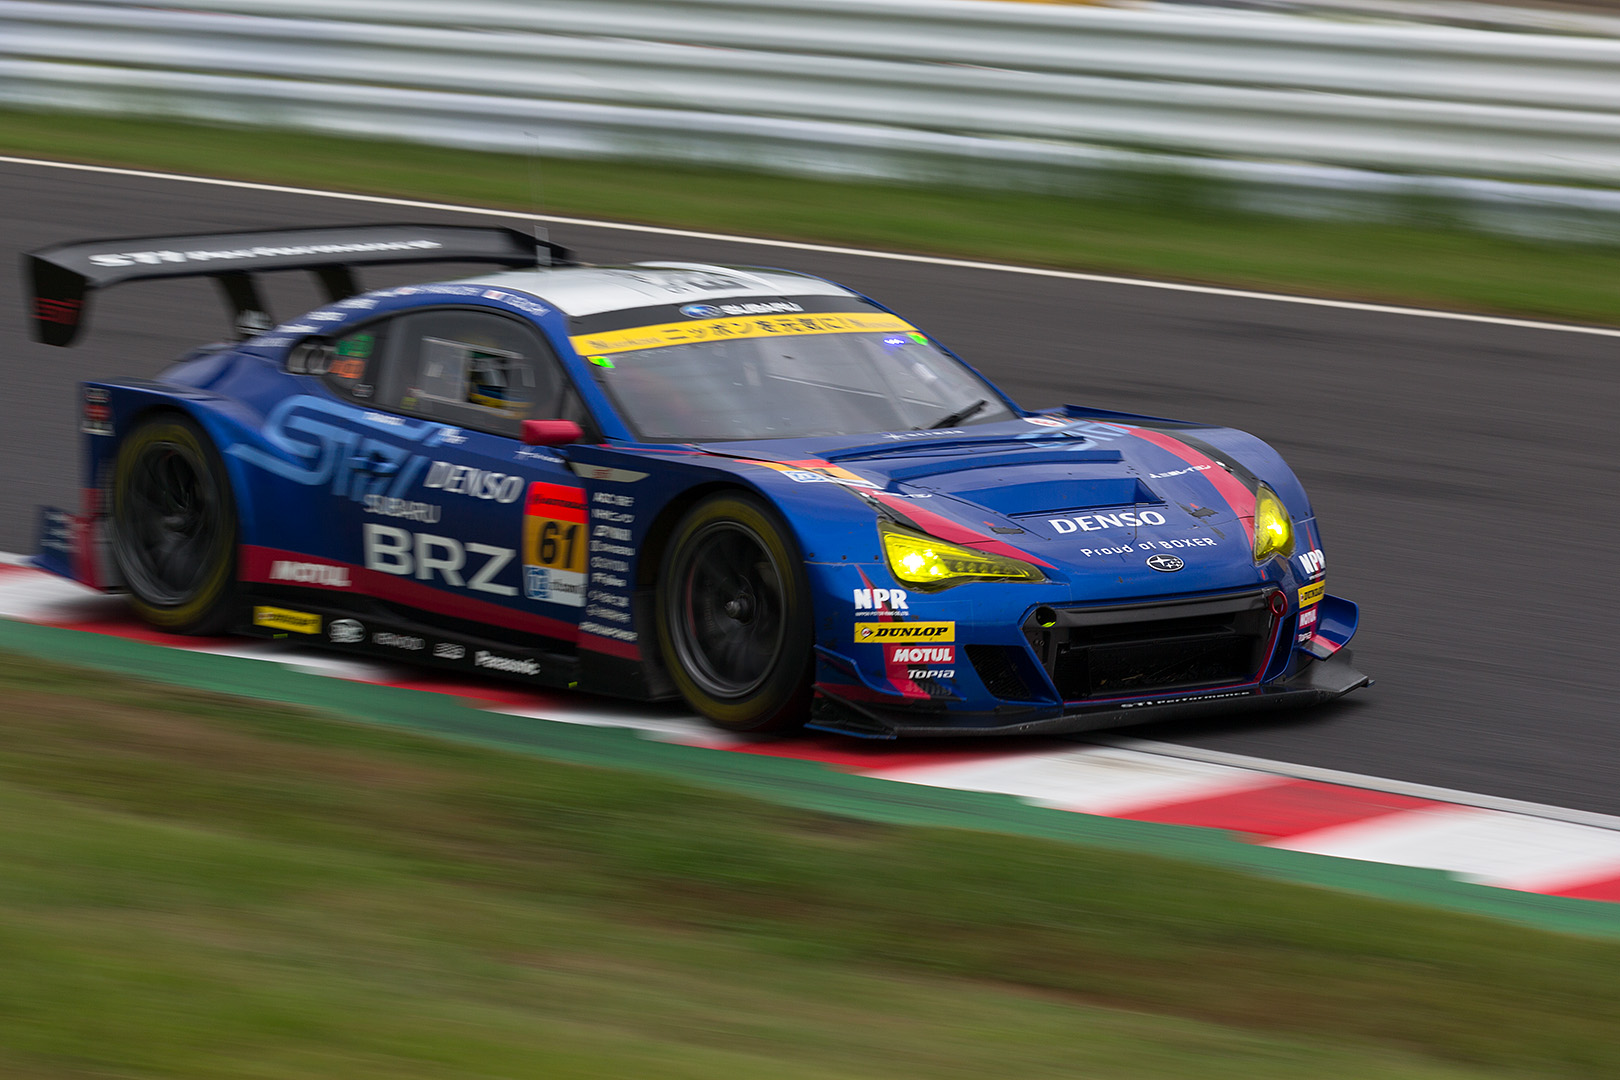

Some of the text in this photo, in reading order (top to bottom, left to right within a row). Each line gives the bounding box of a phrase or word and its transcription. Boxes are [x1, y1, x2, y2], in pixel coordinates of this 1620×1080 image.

[719, 302, 805, 315] SUBARU
[424, 461, 524, 503] DENSO
[363, 494, 442, 524] SUBARU
[1048, 510, 1166, 534] DENSO
[538, 521, 582, 568] 61
[1080, 537, 1218, 558] Proud of BOXER
[363, 523, 518, 596] BRZ
[1298, 549, 1326, 575] NPR
[269, 560, 352, 587] MOTUL
[853, 588, 908, 609] NPR
[874, 627, 948, 637] DUNLOP
[893, 649, 952, 662] MOTUL
